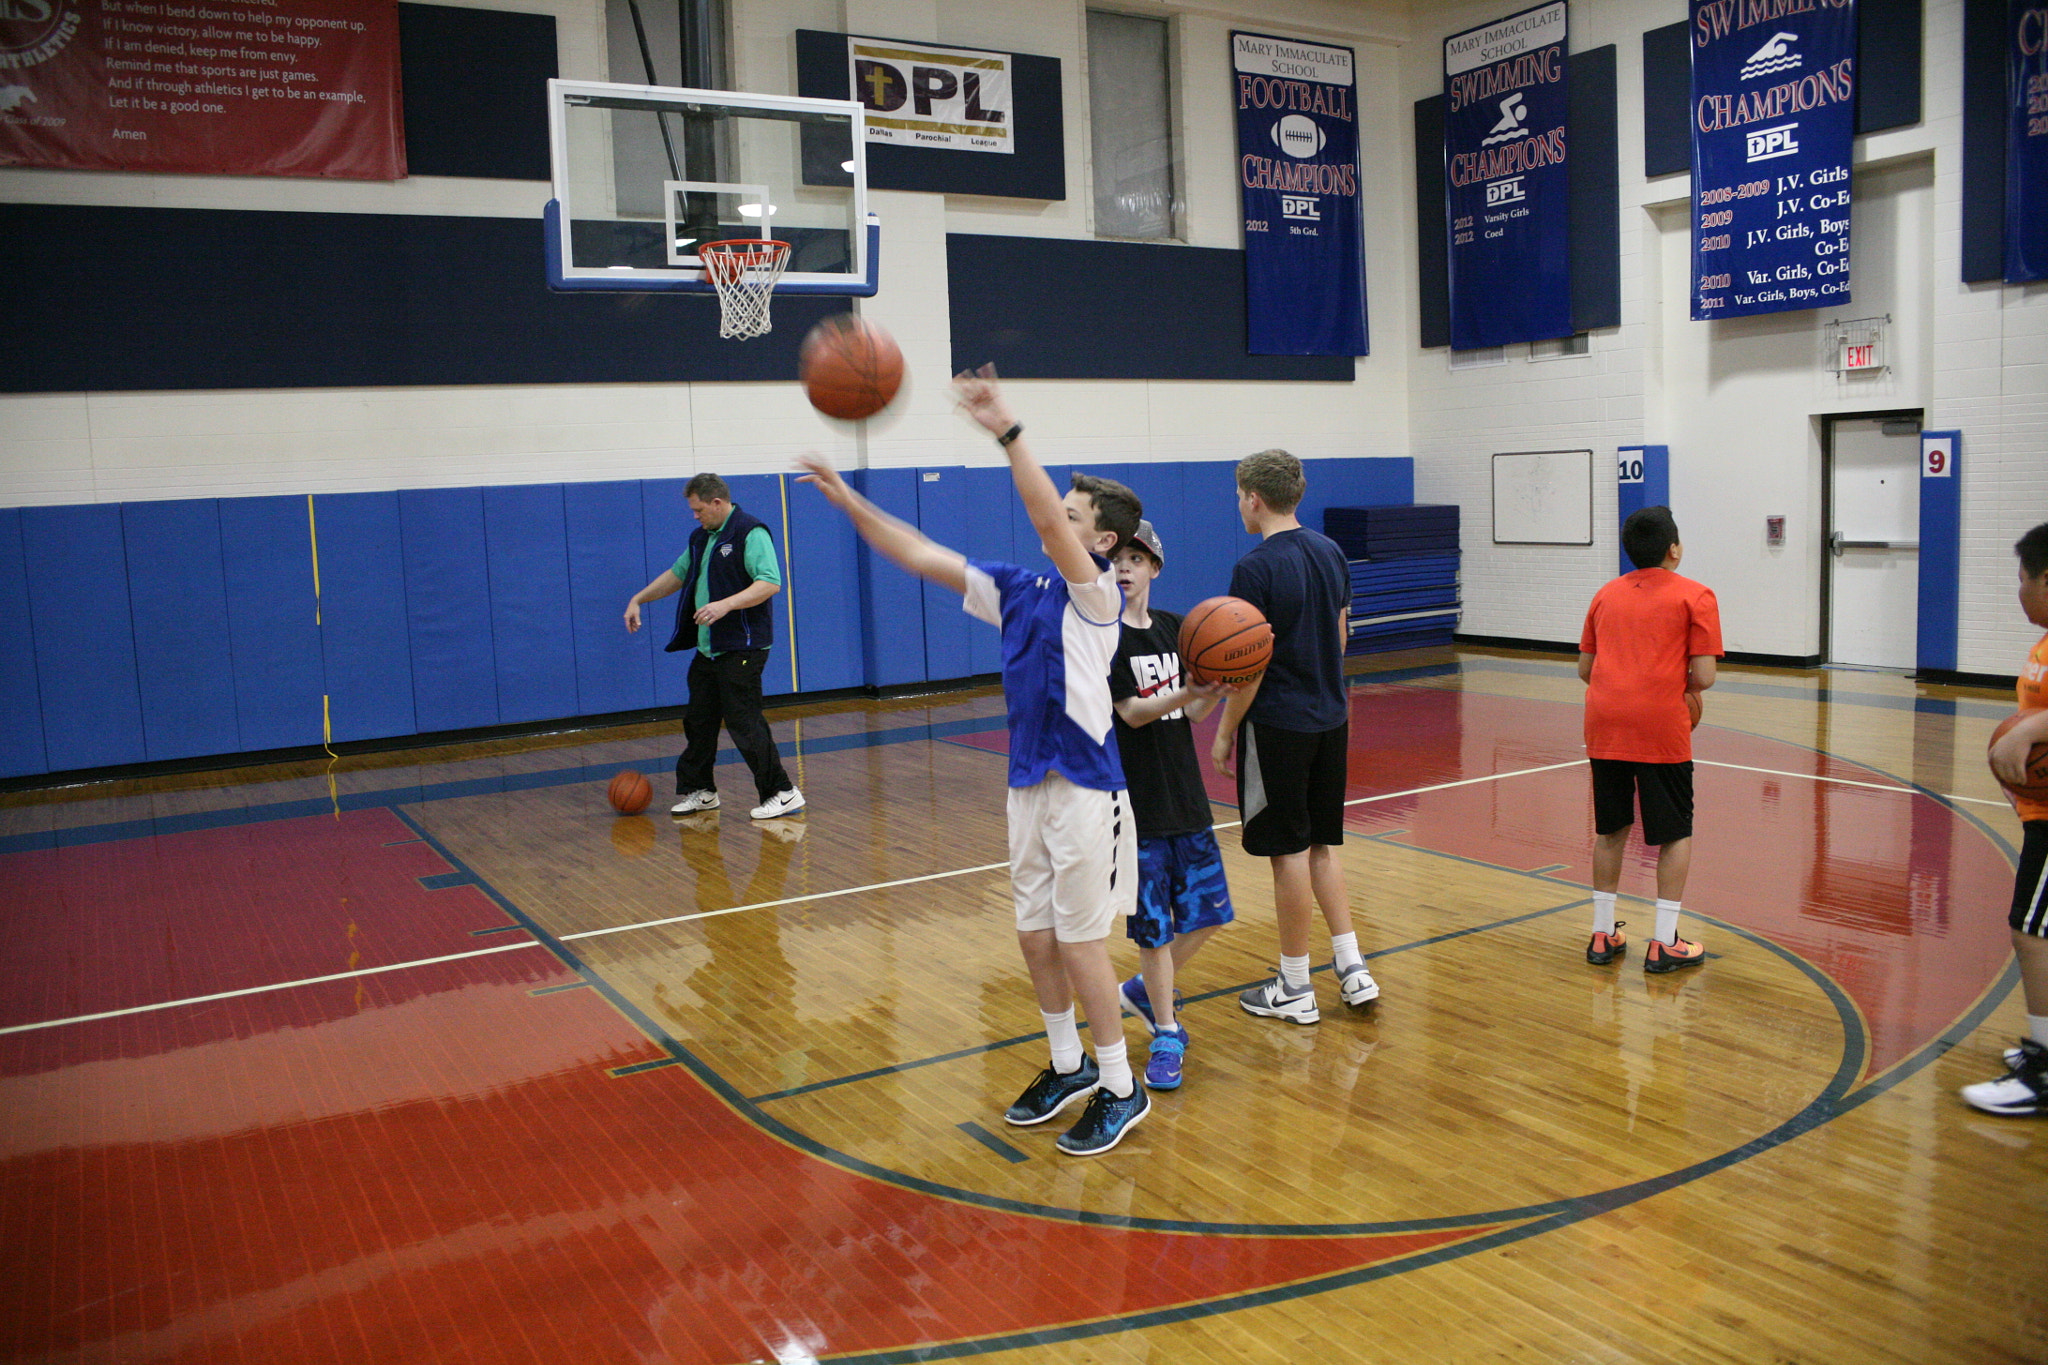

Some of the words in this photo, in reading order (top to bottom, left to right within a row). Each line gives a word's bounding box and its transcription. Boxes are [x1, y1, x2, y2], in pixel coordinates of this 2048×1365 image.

[102, 0, 121, 12] But
[125, 2, 157, 15] when
[167, 5, 195, 18] bend
[199, 7, 230, 21] down
[233, 11, 246, 22] to
[248, 10, 273, 26] help
[275, 15, 292, 28] my
[295, 17, 347, 31] opponent
[350, 21, 367, 34] up.
[103, 19, 112, 30] If
[122, 20, 154, 33] know
[157, 23, 200, 39] victory,
[202, 25, 233, 40] allow
[235, 31, 253, 42] me
[256, 32, 268, 43] to
[271, 32, 285, 44] be
[287, 32, 322, 49] happy.
[1450, 35, 1482, 57] MARY
[1484, 8, 1561, 44] IMMACULATE
[105, 38, 114, 49] If
[124, 41, 142, 51] am
[145, 40, 187, 56] denied,
[190, 44, 217, 60] keep
[220, 49, 238, 60] me
[240, 47, 268, 61] from
[270, 52, 299, 65] envy.
[1238, 38, 1273, 57] MARY
[1275, 44, 1349, 68] IMMACULATE
[1480, 37, 1528, 63] SCHOOL
[106, 57, 151, 72] Remind
[154, 62, 172, 74] me
[175, 61, 199, 75] that
[201, 64, 237, 79] sports
[239, 68, 257, 79] are
[259, 66, 279, 82] just
[282, 70, 319, 84] games.
[1271, 59, 1319, 79] SCHOOL
[1451, 46, 1561, 113] SWIMMING
[108, 76, 132, 89] And
[134, 76, 143, 90] if
[146, 79, 192, 96] through
[194, 82, 243, 96] athletics
[252, 87, 269, 100] get
[272, 87, 285, 99] to
[287, 86, 301, 99] be
[303, 89, 316, 100] an
[318, 90, 367, 105] example,
[855, 59, 1006, 123] DPL
[1238, 74, 1353, 122] FOOTBALL
[1698, 58, 1853, 133] CHAMPIONS
[109, 96, 128, 109] Let
[131, 96, 140, 109] it
[144, 97, 158, 110] be
[160, 101, 168, 111] a
[170, 99, 200, 115] good
[202, 103, 227, 115] one.
[112, 128, 147, 141] Amen
[869, 127, 893, 138] Dallas
[915, 132, 952, 144] Parochial
[971, 137, 998, 148] League
[1746, 130, 1799, 158] DPL
[1451, 126, 1566, 188] CHAMPIONS
[1241, 153, 1356, 197] CHAMPIONS
[1700, 179, 1771, 206] 2008-2009
[1776, 174, 1804, 195] J.V.
[1809, 166, 1849, 186] Girls
[1486, 180, 1526, 204] DPL
[1282, 199, 1321, 217] DPL
[1454, 215, 1474, 231] 2012
[1484, 210, 1509, 225] Varsity
[1510, 207, 1530, 219] Girls
[1700, 209, 1734, 229] 2009
[1776, 198, 1804, 219] J.V.
[1246, 219, 1269, 232] 2012
[1289, 225, 1301, 236] 5th
[1302, 226, 1319, 237] Grd.
[1454, 230, 1474, 246] 2012
[1484, 228, 1504, 240] Coed
[1701, 234, 1732, 252] 2010
[1746, 229, 1771, 249] J.V.
[1775, 222, 1815, 241] Girls,
[1814, 237, 1849, 256] Co-E
[1701, 273, 1732, 290] 2010
[1747, 270, 1771, 285] Var.
[1775, 263, 1813, 281] Girls,
[1701, 297, 1726, 309] 2011
[1735, 294, 1756, 306] Var.
[1757, 289, 1787, 303] Girls,
[1789, 286, 1819, 300] Boys,
[1847, 344, 1874, 368] EXIT
[1618, 459, 1644, 480] 10
[1928, 449, 1946, 474] 9
